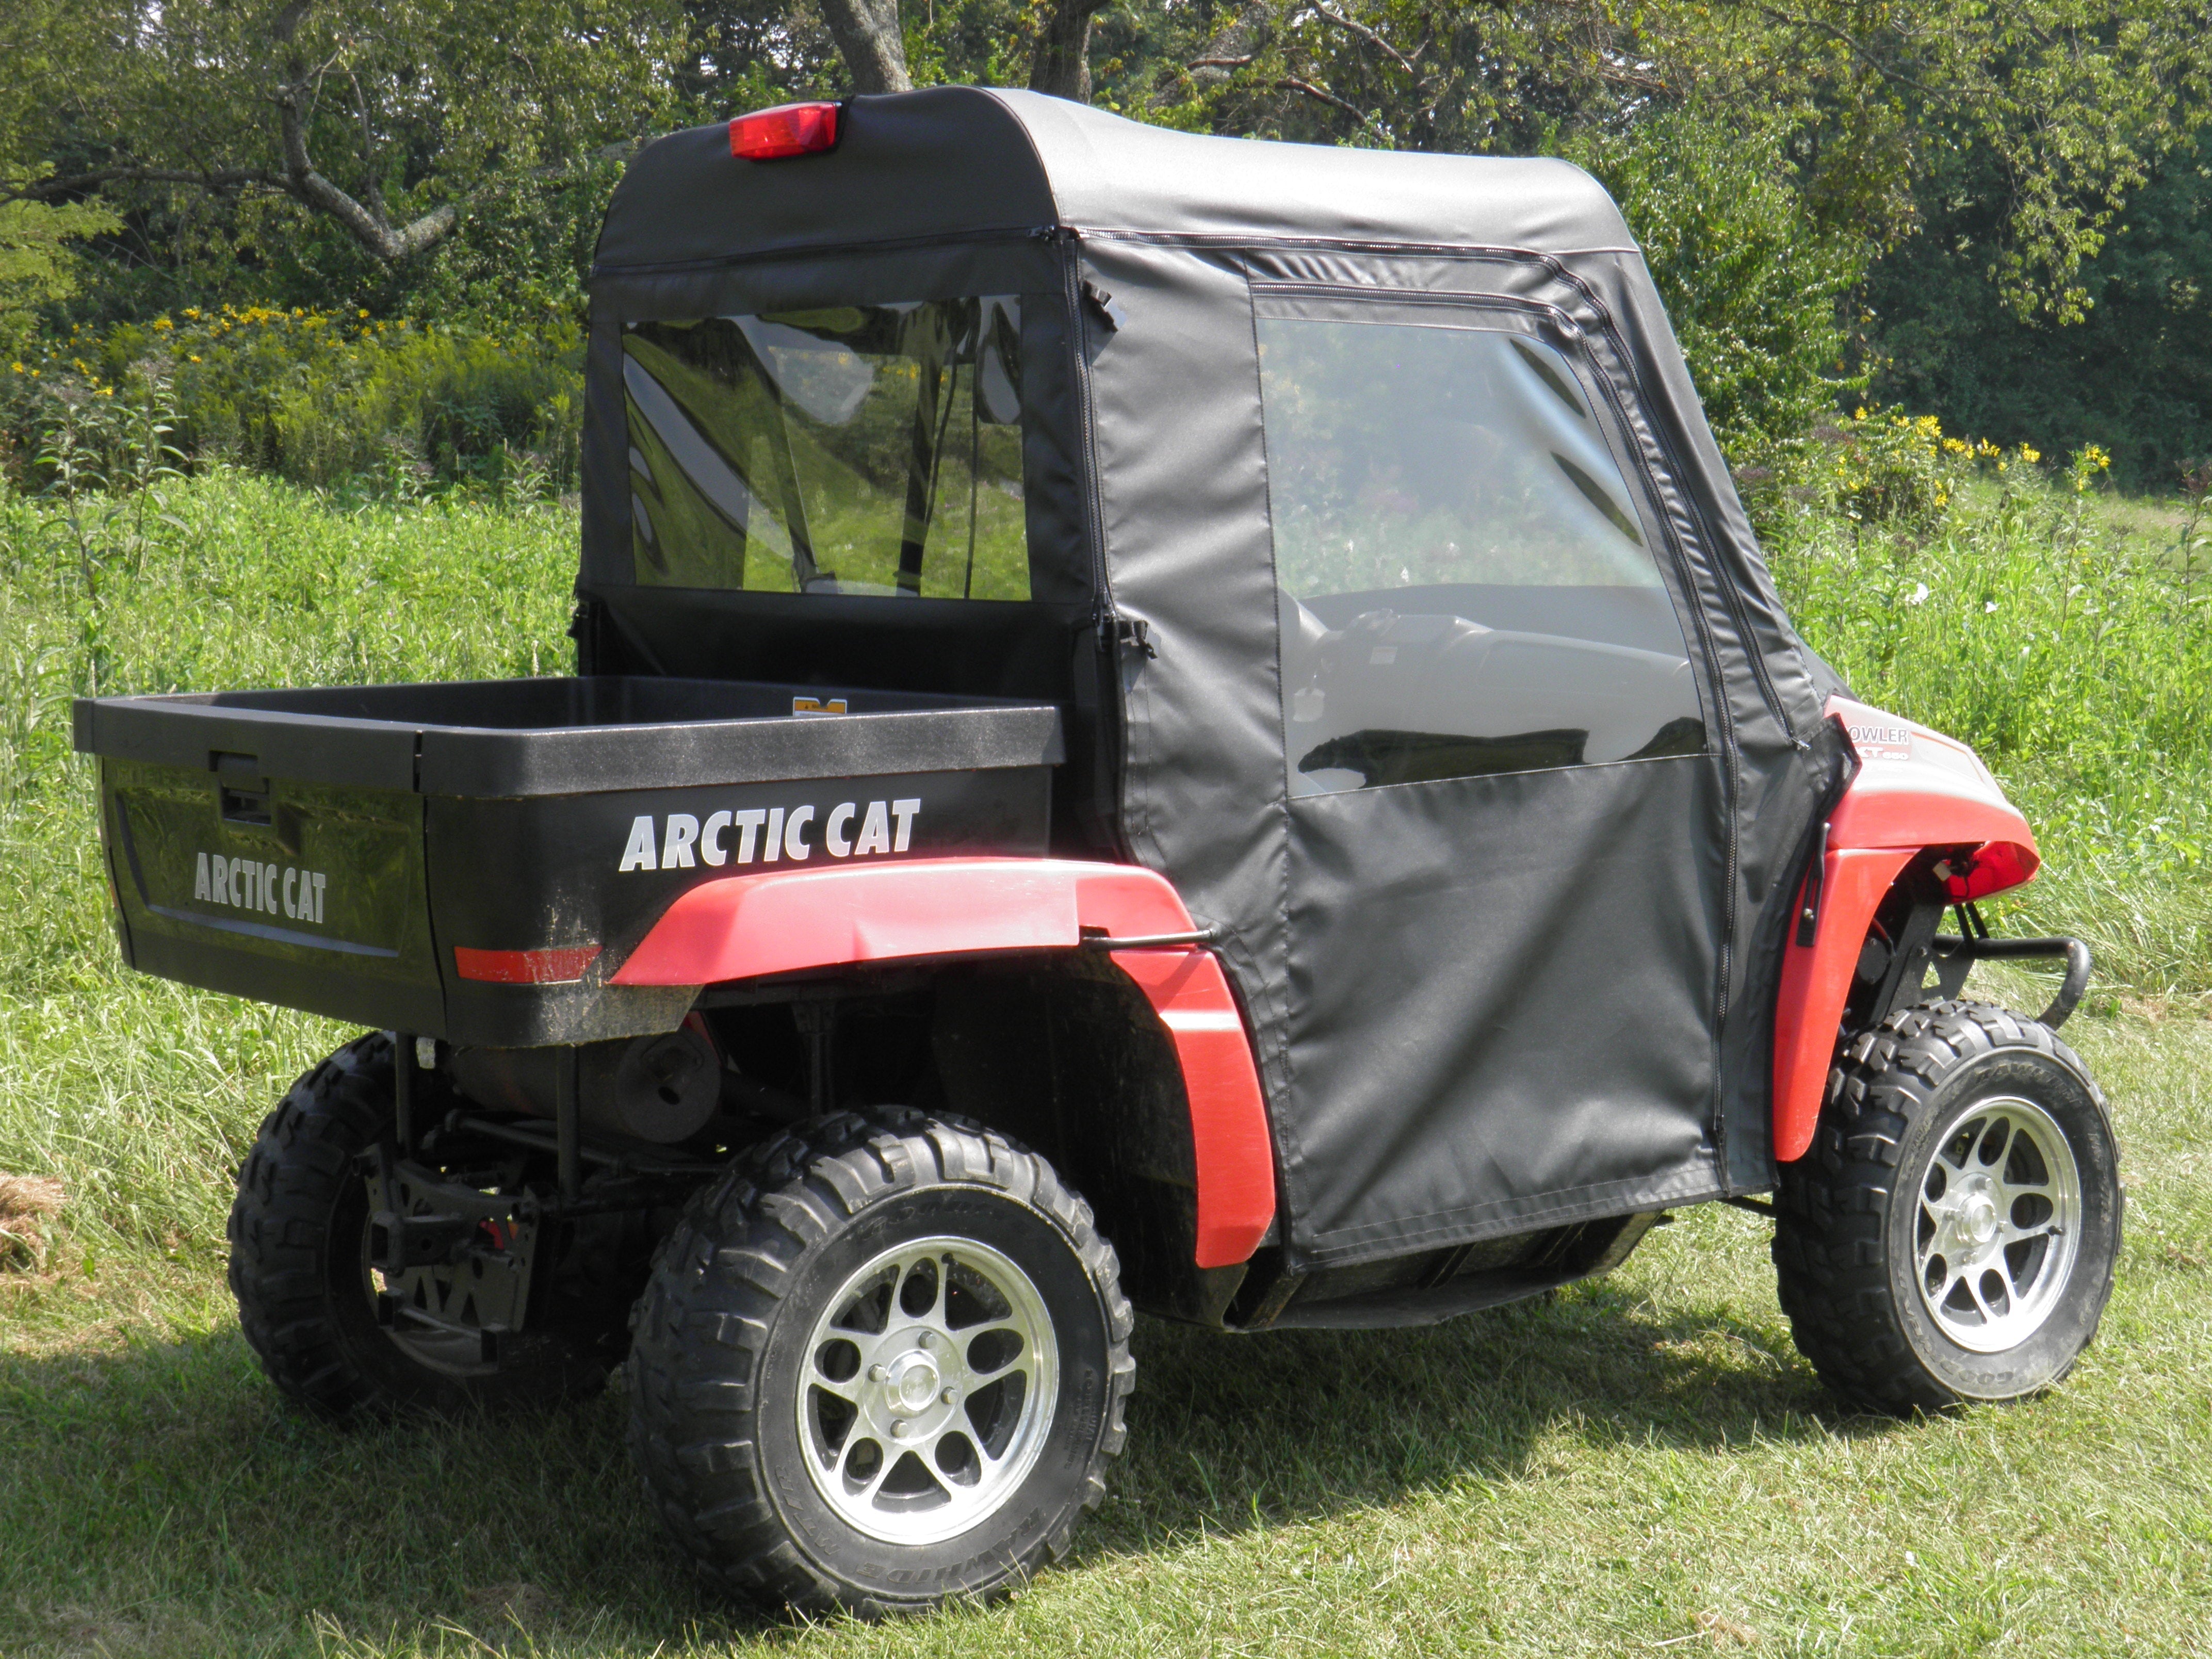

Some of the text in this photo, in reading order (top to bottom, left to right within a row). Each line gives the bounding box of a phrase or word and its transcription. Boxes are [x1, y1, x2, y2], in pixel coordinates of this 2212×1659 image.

[1848, 726, 1909, 745] OWLER
[1882, 752, 1909, 760] 650
[619, 799, 920, 871] ARCTIC CAT
[195, 852, 326, 923] ARCTIC CAT
[854, 1507, 1042, 1583] RAWHIDE
